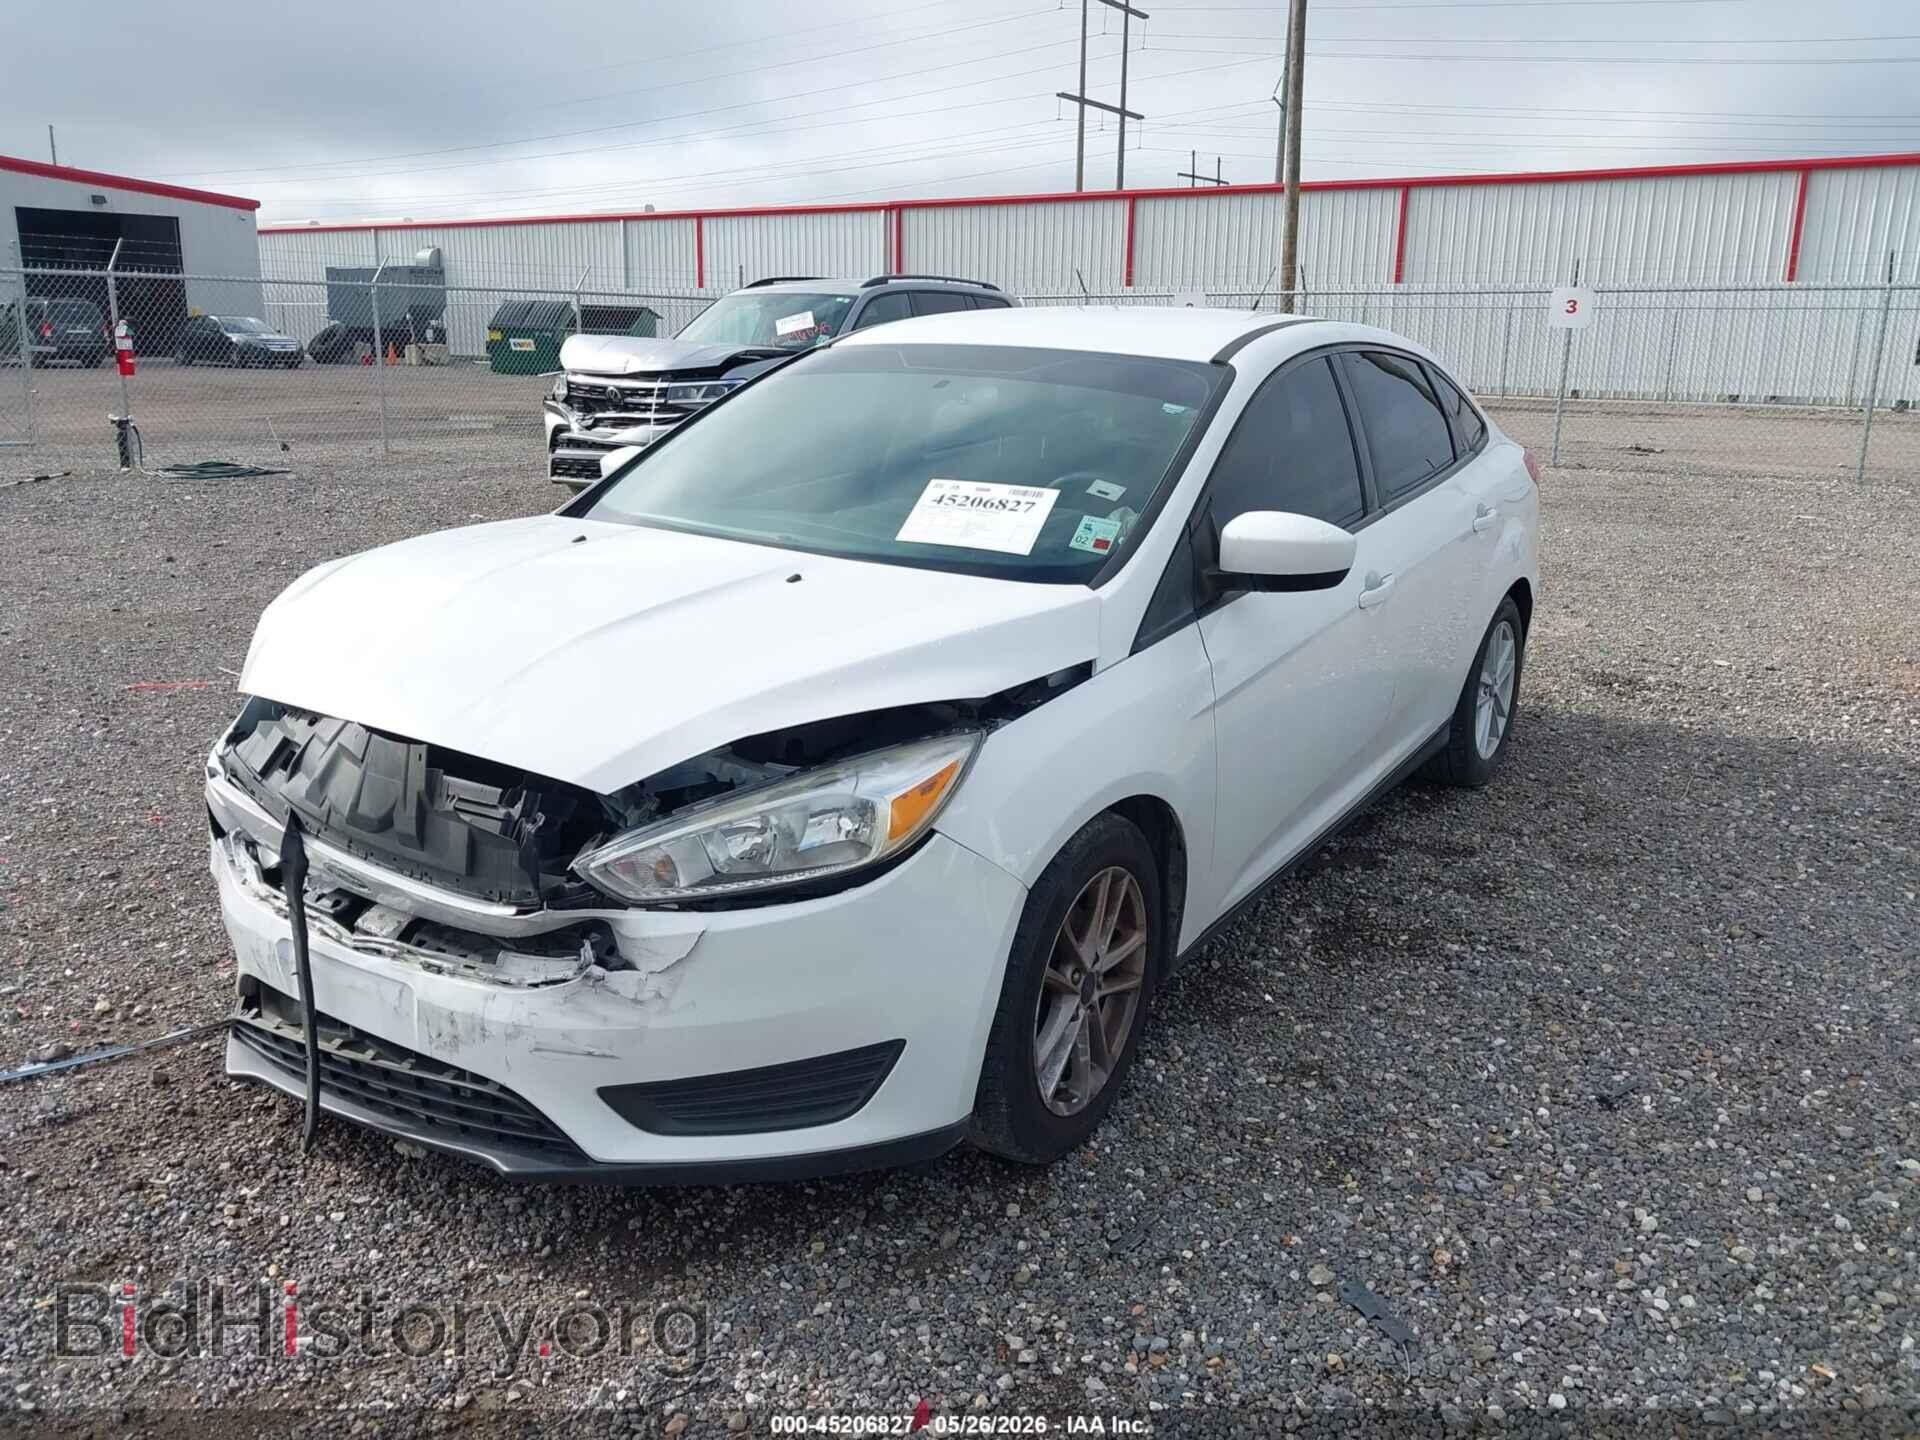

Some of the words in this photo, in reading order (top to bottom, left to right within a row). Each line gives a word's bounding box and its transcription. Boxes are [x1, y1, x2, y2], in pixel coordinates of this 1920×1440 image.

[1566, 299, 1577, 313] 3
[931, 493, 1036, 513] 45206827
[1075, 535, 1089, 545] 02
